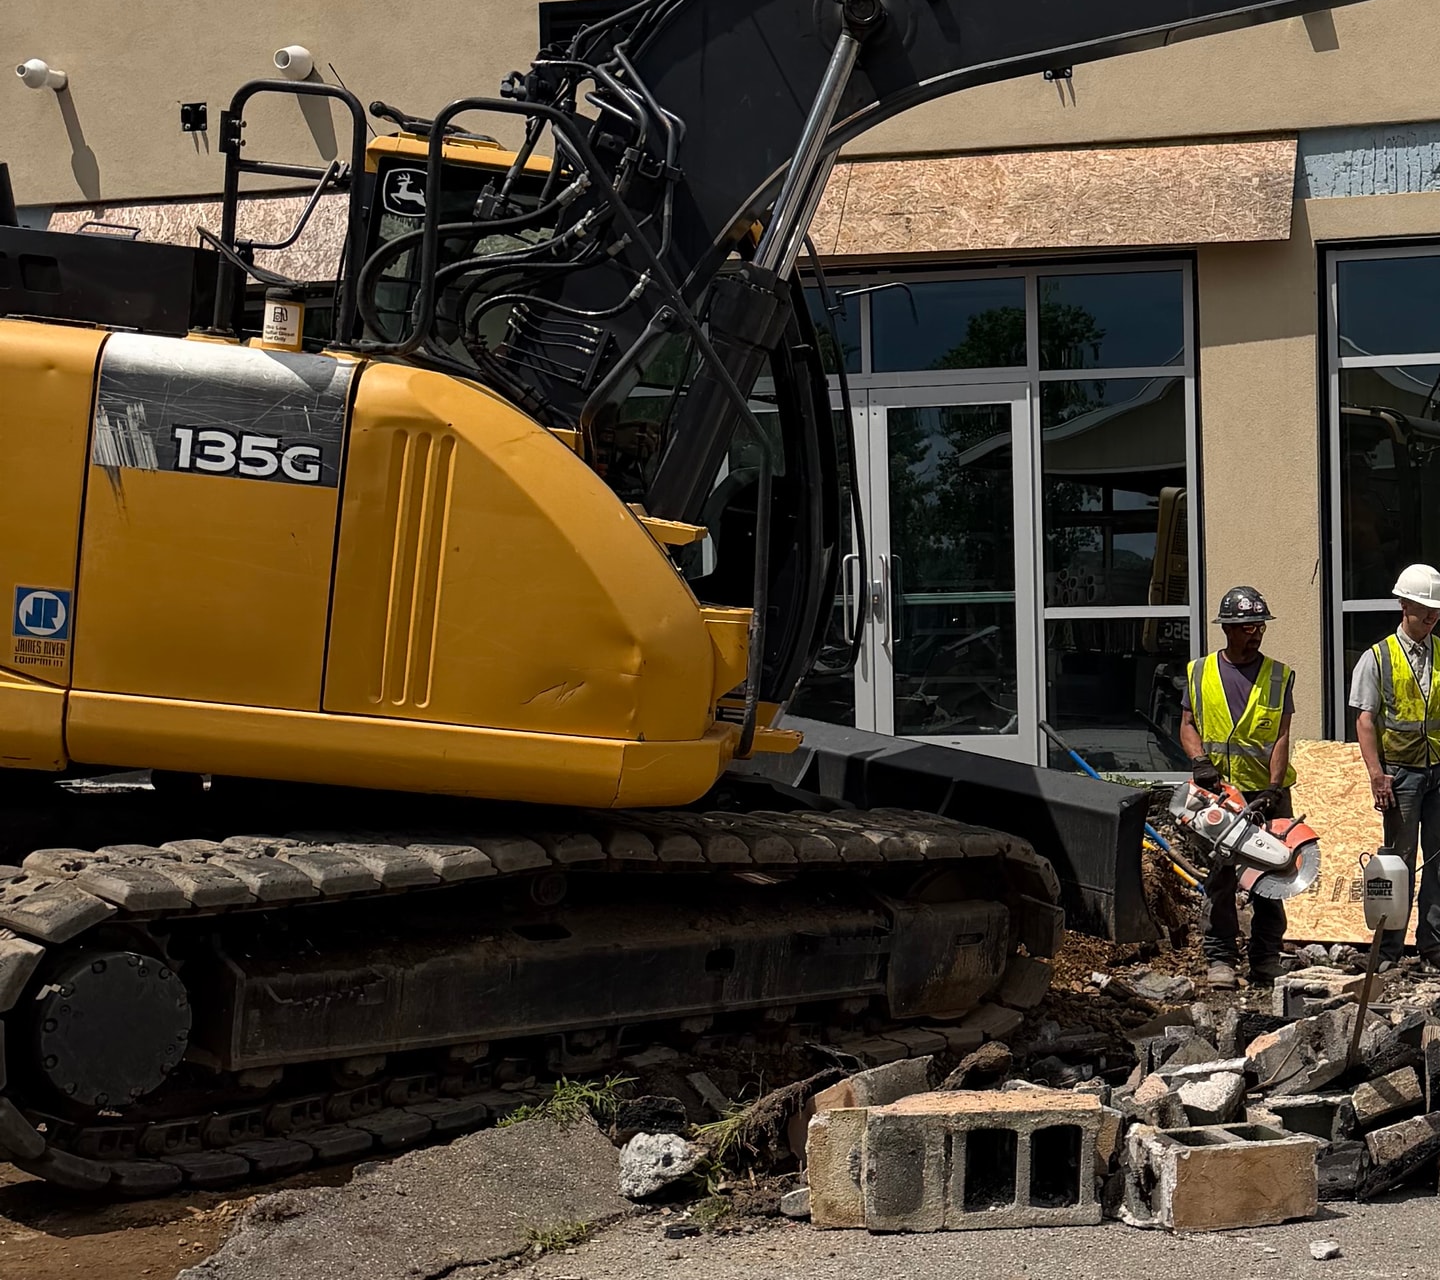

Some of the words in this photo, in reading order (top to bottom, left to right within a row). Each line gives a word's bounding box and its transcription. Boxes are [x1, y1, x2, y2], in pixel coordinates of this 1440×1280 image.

[174, 428, 321, 482] 135G
[25, 596, 60, 630] JR
[15, 638, 42, 655] JAMES
[43, 640, 66, 657] RIVER
